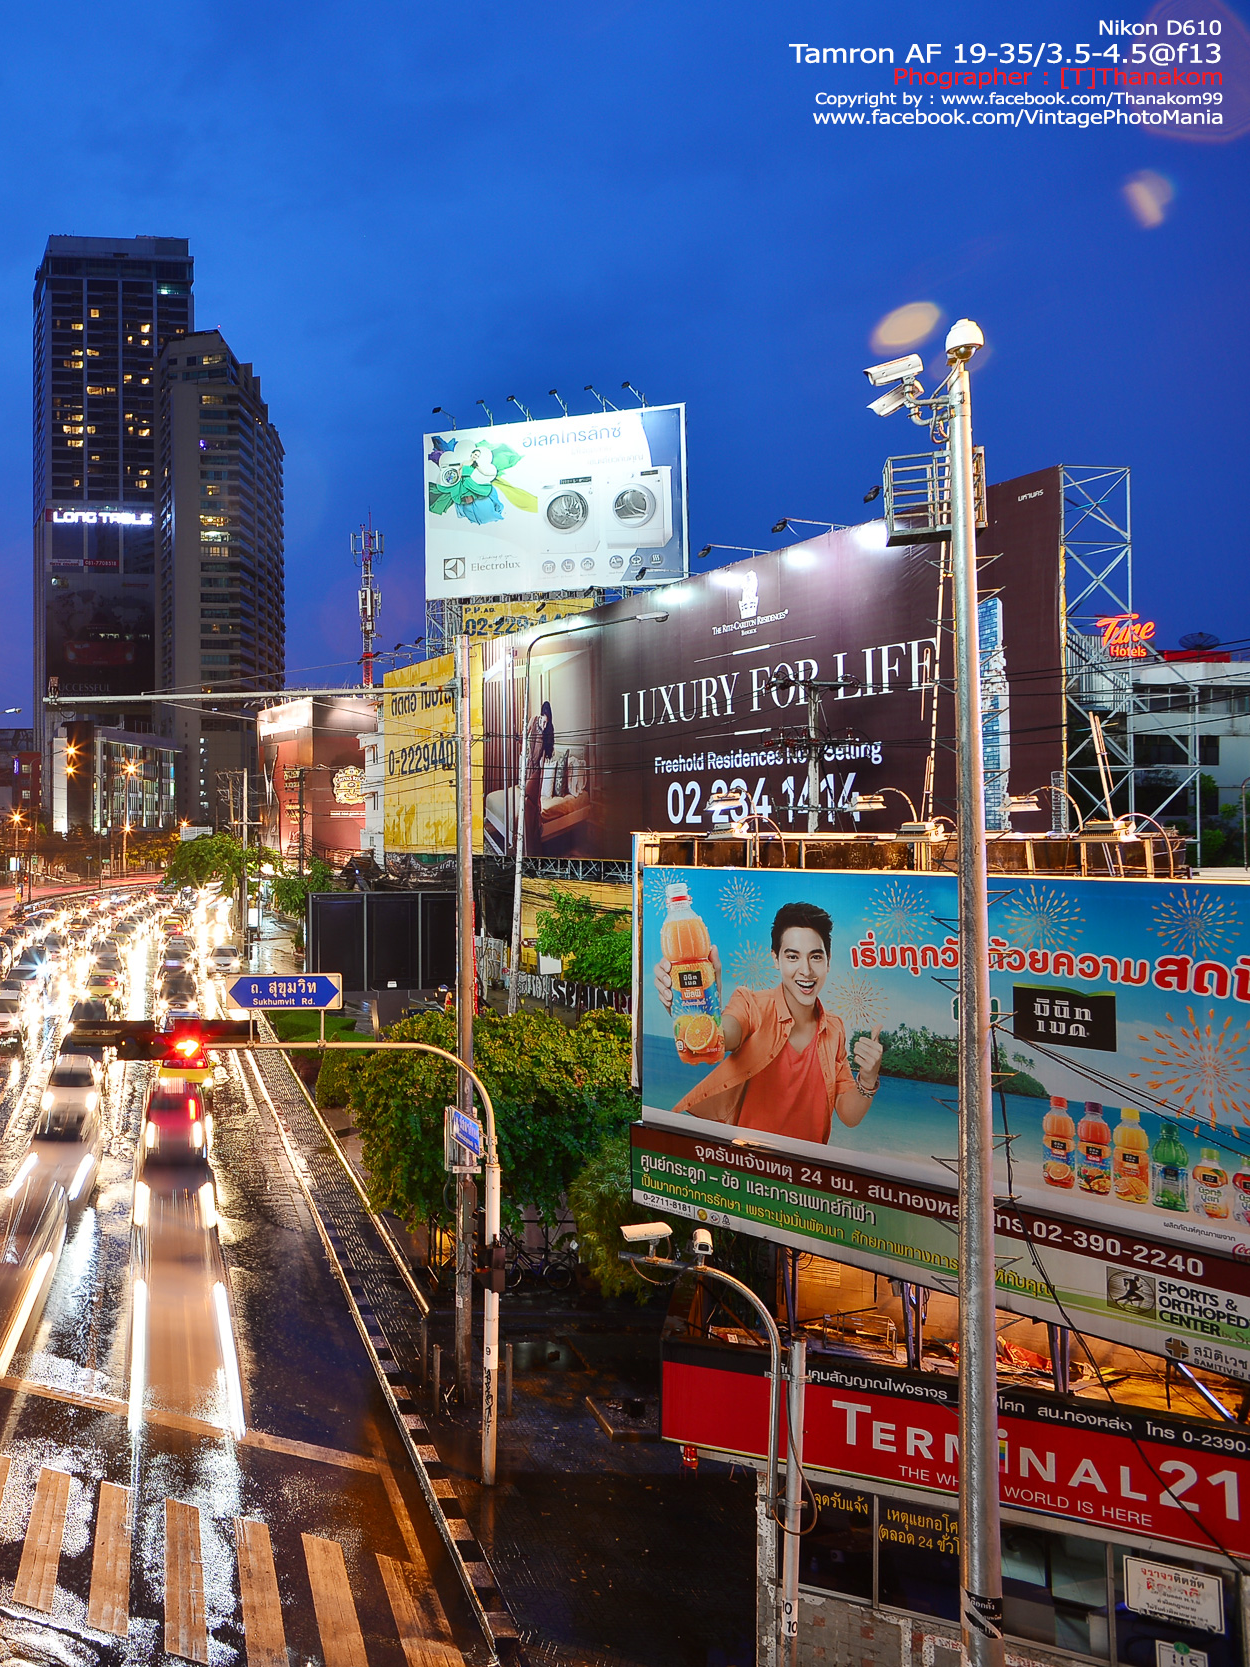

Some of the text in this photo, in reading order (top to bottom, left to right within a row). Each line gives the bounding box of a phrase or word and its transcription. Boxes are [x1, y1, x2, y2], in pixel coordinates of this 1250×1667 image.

[53, 511, 153, 525] LONG TABLE
[470, 560, 521, 573] Electrolux
[1096, 613, 1156, 648] Tune
[1109, 645, 1147, 658] Hotels
[56, 683, 110, 692] UCCESSFUL
[621, 637, 938, 730] LUXURY FOR LIFE
[655, 752, 705, 774] Freehold
[707, 747, 784, 771] Residences
[786, 746, 807, 765] No
[667, 781, 702, 824] 02
[711, 776, 772, 823] 234
[251, 978, 317, 997] ถ. สุขุมวิท
[253, 997, 316, 1006] Sukhumvit Rd.
[640, 1154, 706, 1186] ศูนย์กระดูก
[721, 1170, 740, 1191] ข้อ
[746, 1179, 876, 1226] และการแพทย์กีฬา
[694, 1145, 793, 1184] จุดรับแจ้งเหตุ
[800, 1168, 823, 1185] 24
[831, 1175, 859, 1194] ชม.
[868, 1183, 959, 1218] สน.ทองหล
[641, 1173, 742, 1213] เป็นมากกว่าการรักษา
[746, 1204, 844, 1240] เพราะมุ่งมั่นพัฒนา
[642, 1192, 692, 1214] 0-2711-8181
[1158, 1281, 1238, 1312] SPORTS &
[1158, 1310, 1221, 1337] CENTER
[1193, 1346, 1248, 1371] สมิติเวช
[1193, 1358, 1245, 1379] SAMITIVEJ
[997, 1396, 1025, 1414] โศก
[1146, 1421, 1176, 1441] โทร
[814, 1492, 868, 1515] จุดรับแจ้ง
[899, 1464, 1153, 1528] THE WH WORLD IS HERE
[887, 1507, 959, 1534] เหตุแยกอโศ
[878, 1523, 959, 1555] (ตลอด 24 ชั่วโ
[782, 1600, 793, 1615] 10
[787, 1621, 797, 1634] 10
